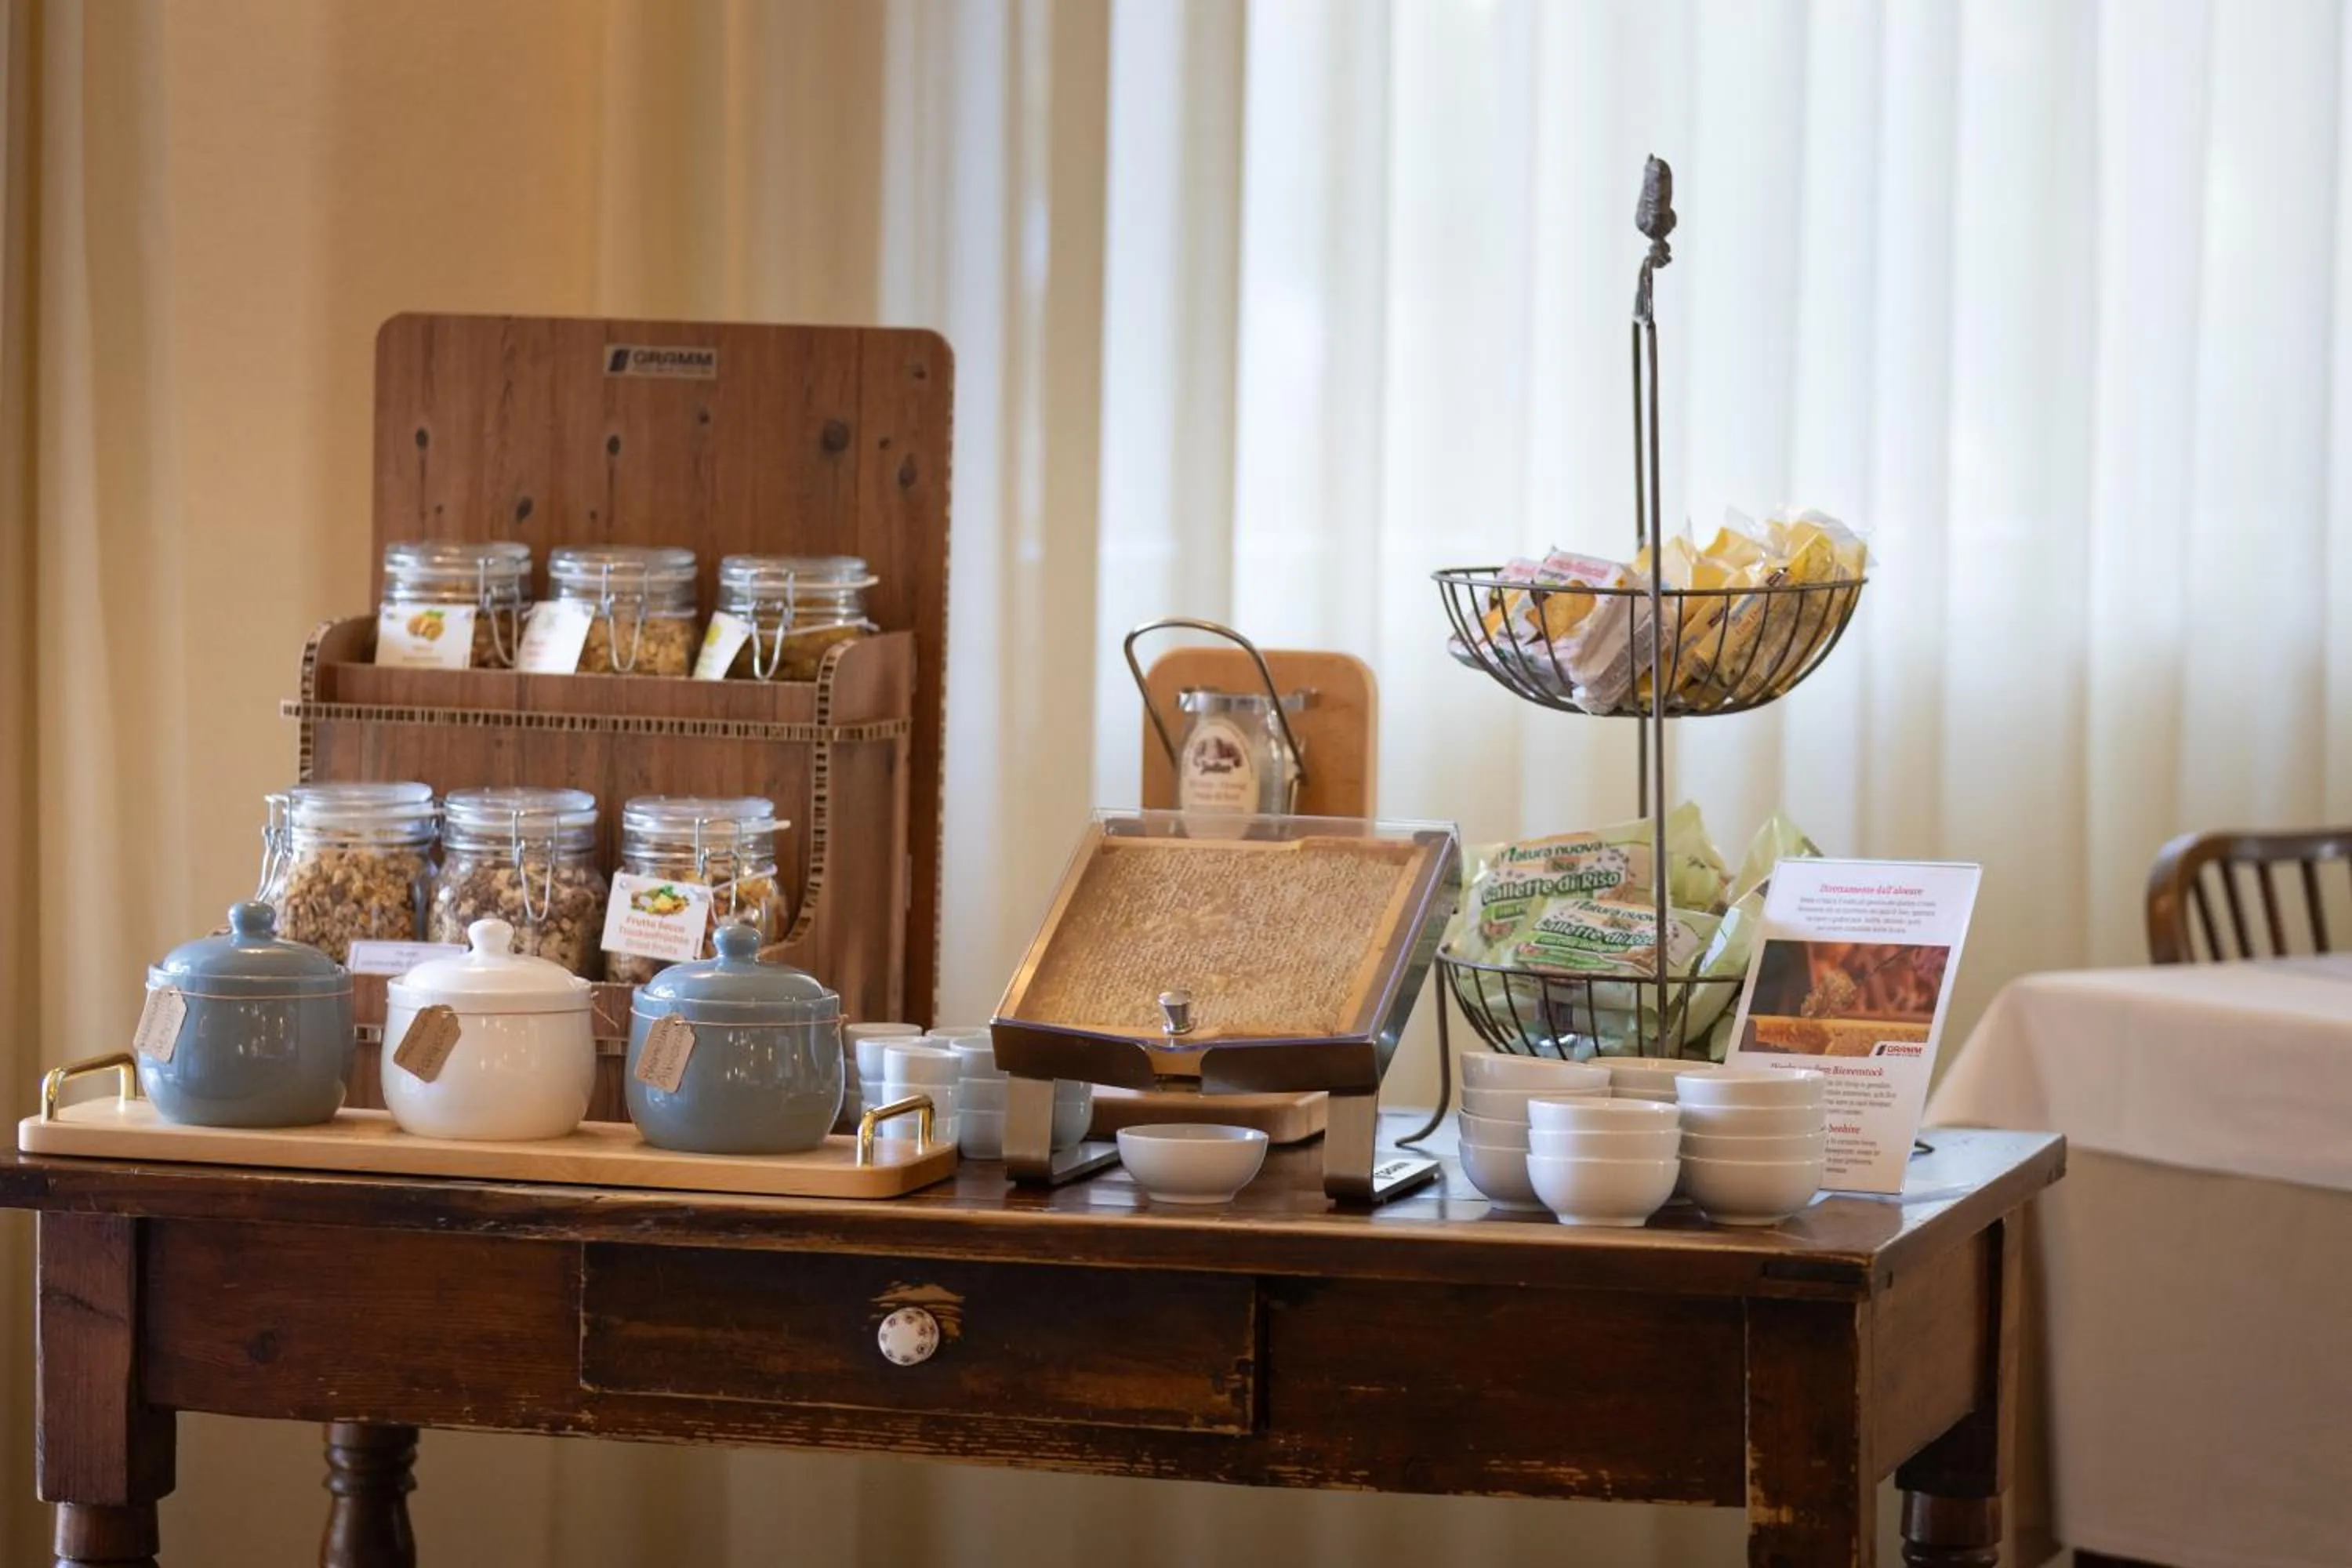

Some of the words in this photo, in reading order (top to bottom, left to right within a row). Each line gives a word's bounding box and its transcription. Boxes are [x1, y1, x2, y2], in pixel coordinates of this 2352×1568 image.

[633, 350, 713, 365] GRAMM
[1558, 874, 1578, 892] di
[1580, 870, 1621, 888] Riso
[1621, 911, 1656, 922] nuov
[1887, 1044, 1923, 1054] GRAMM
